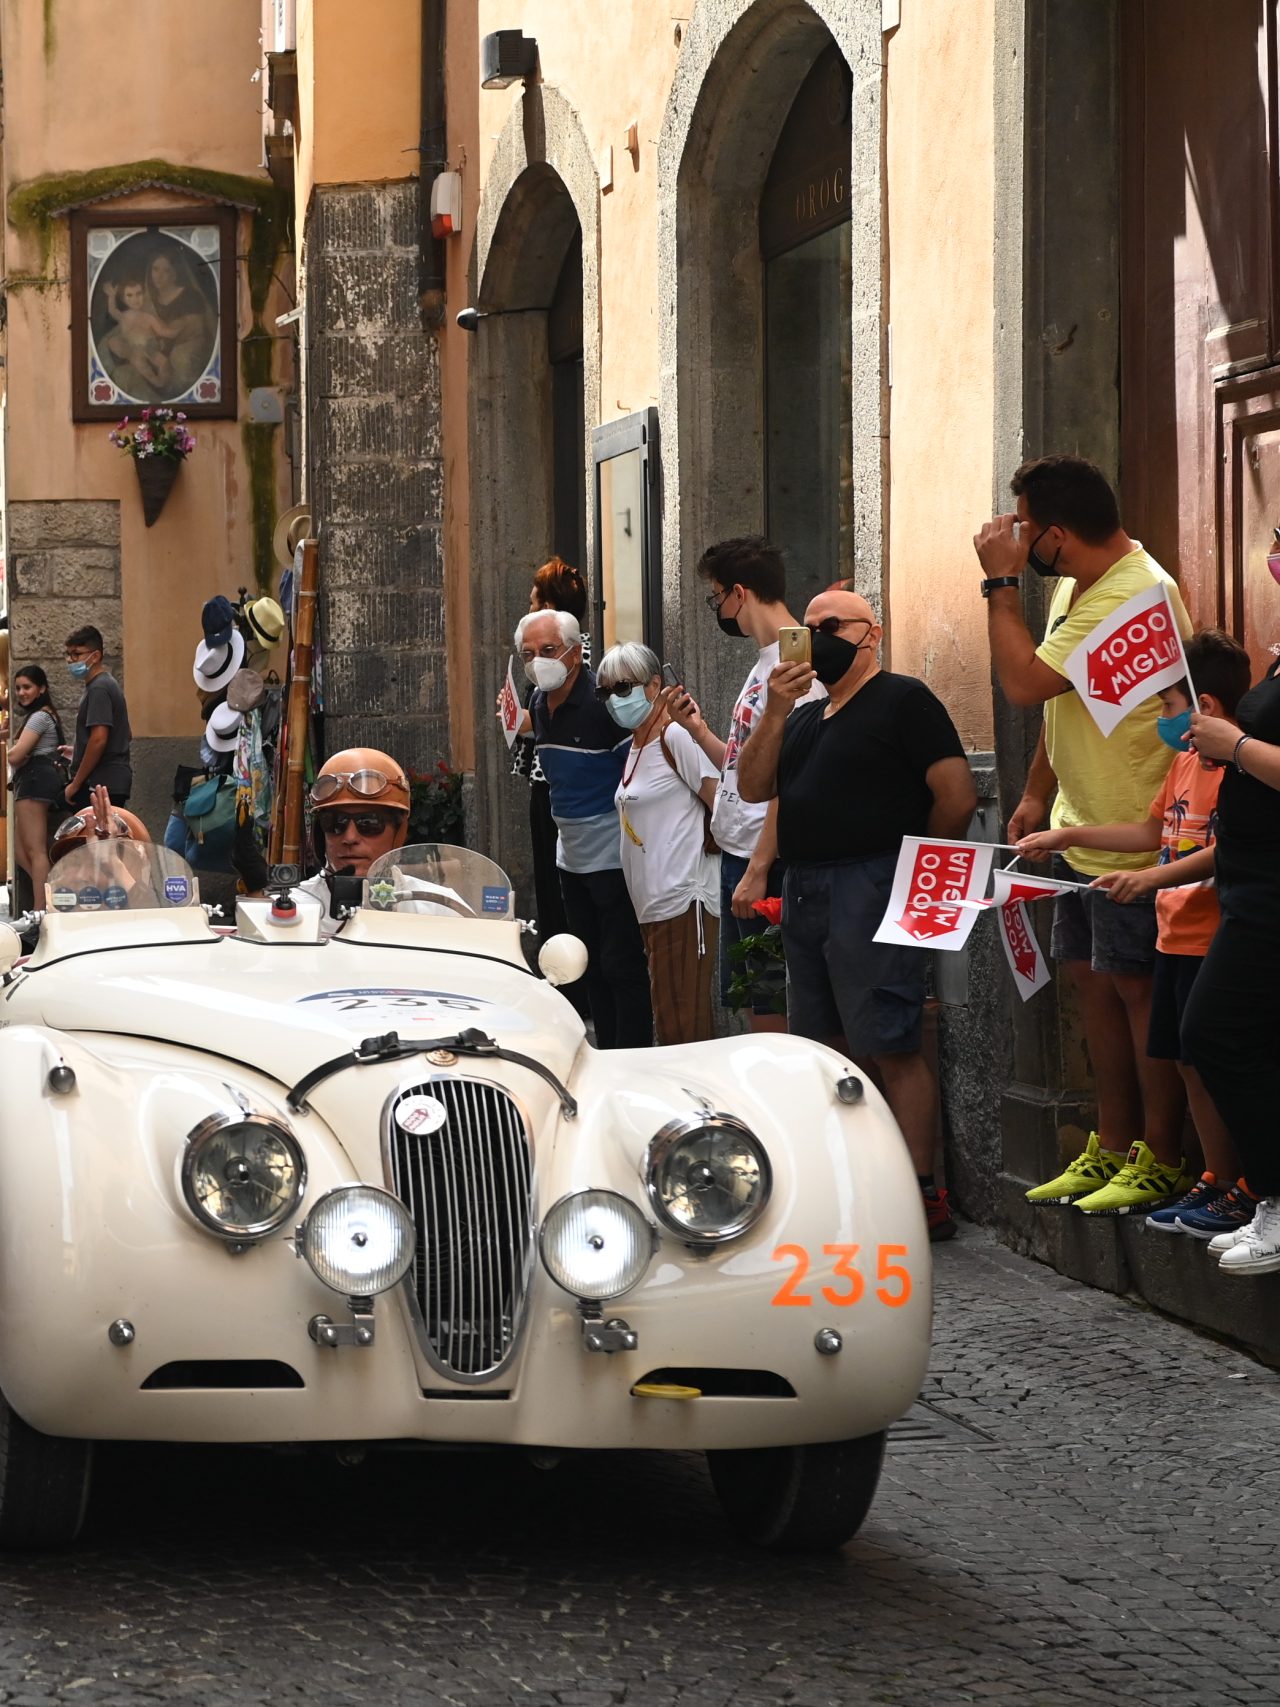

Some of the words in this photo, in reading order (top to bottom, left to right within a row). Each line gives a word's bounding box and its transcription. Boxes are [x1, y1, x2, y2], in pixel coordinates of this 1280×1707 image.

[1101, 612, 1167, 666] 1000
[1111, 636, 1179, 695] MIGLIA
[909, 853, 941, 919] 1000
[934, 852, 971, 926] MIGLIA
[1003, 908, 1021, 958] 100
[1011, 903, 1033, 954] MIGL
[331, 997, 481, 1012] 235
[770, 1243, 913, 1308] 235
